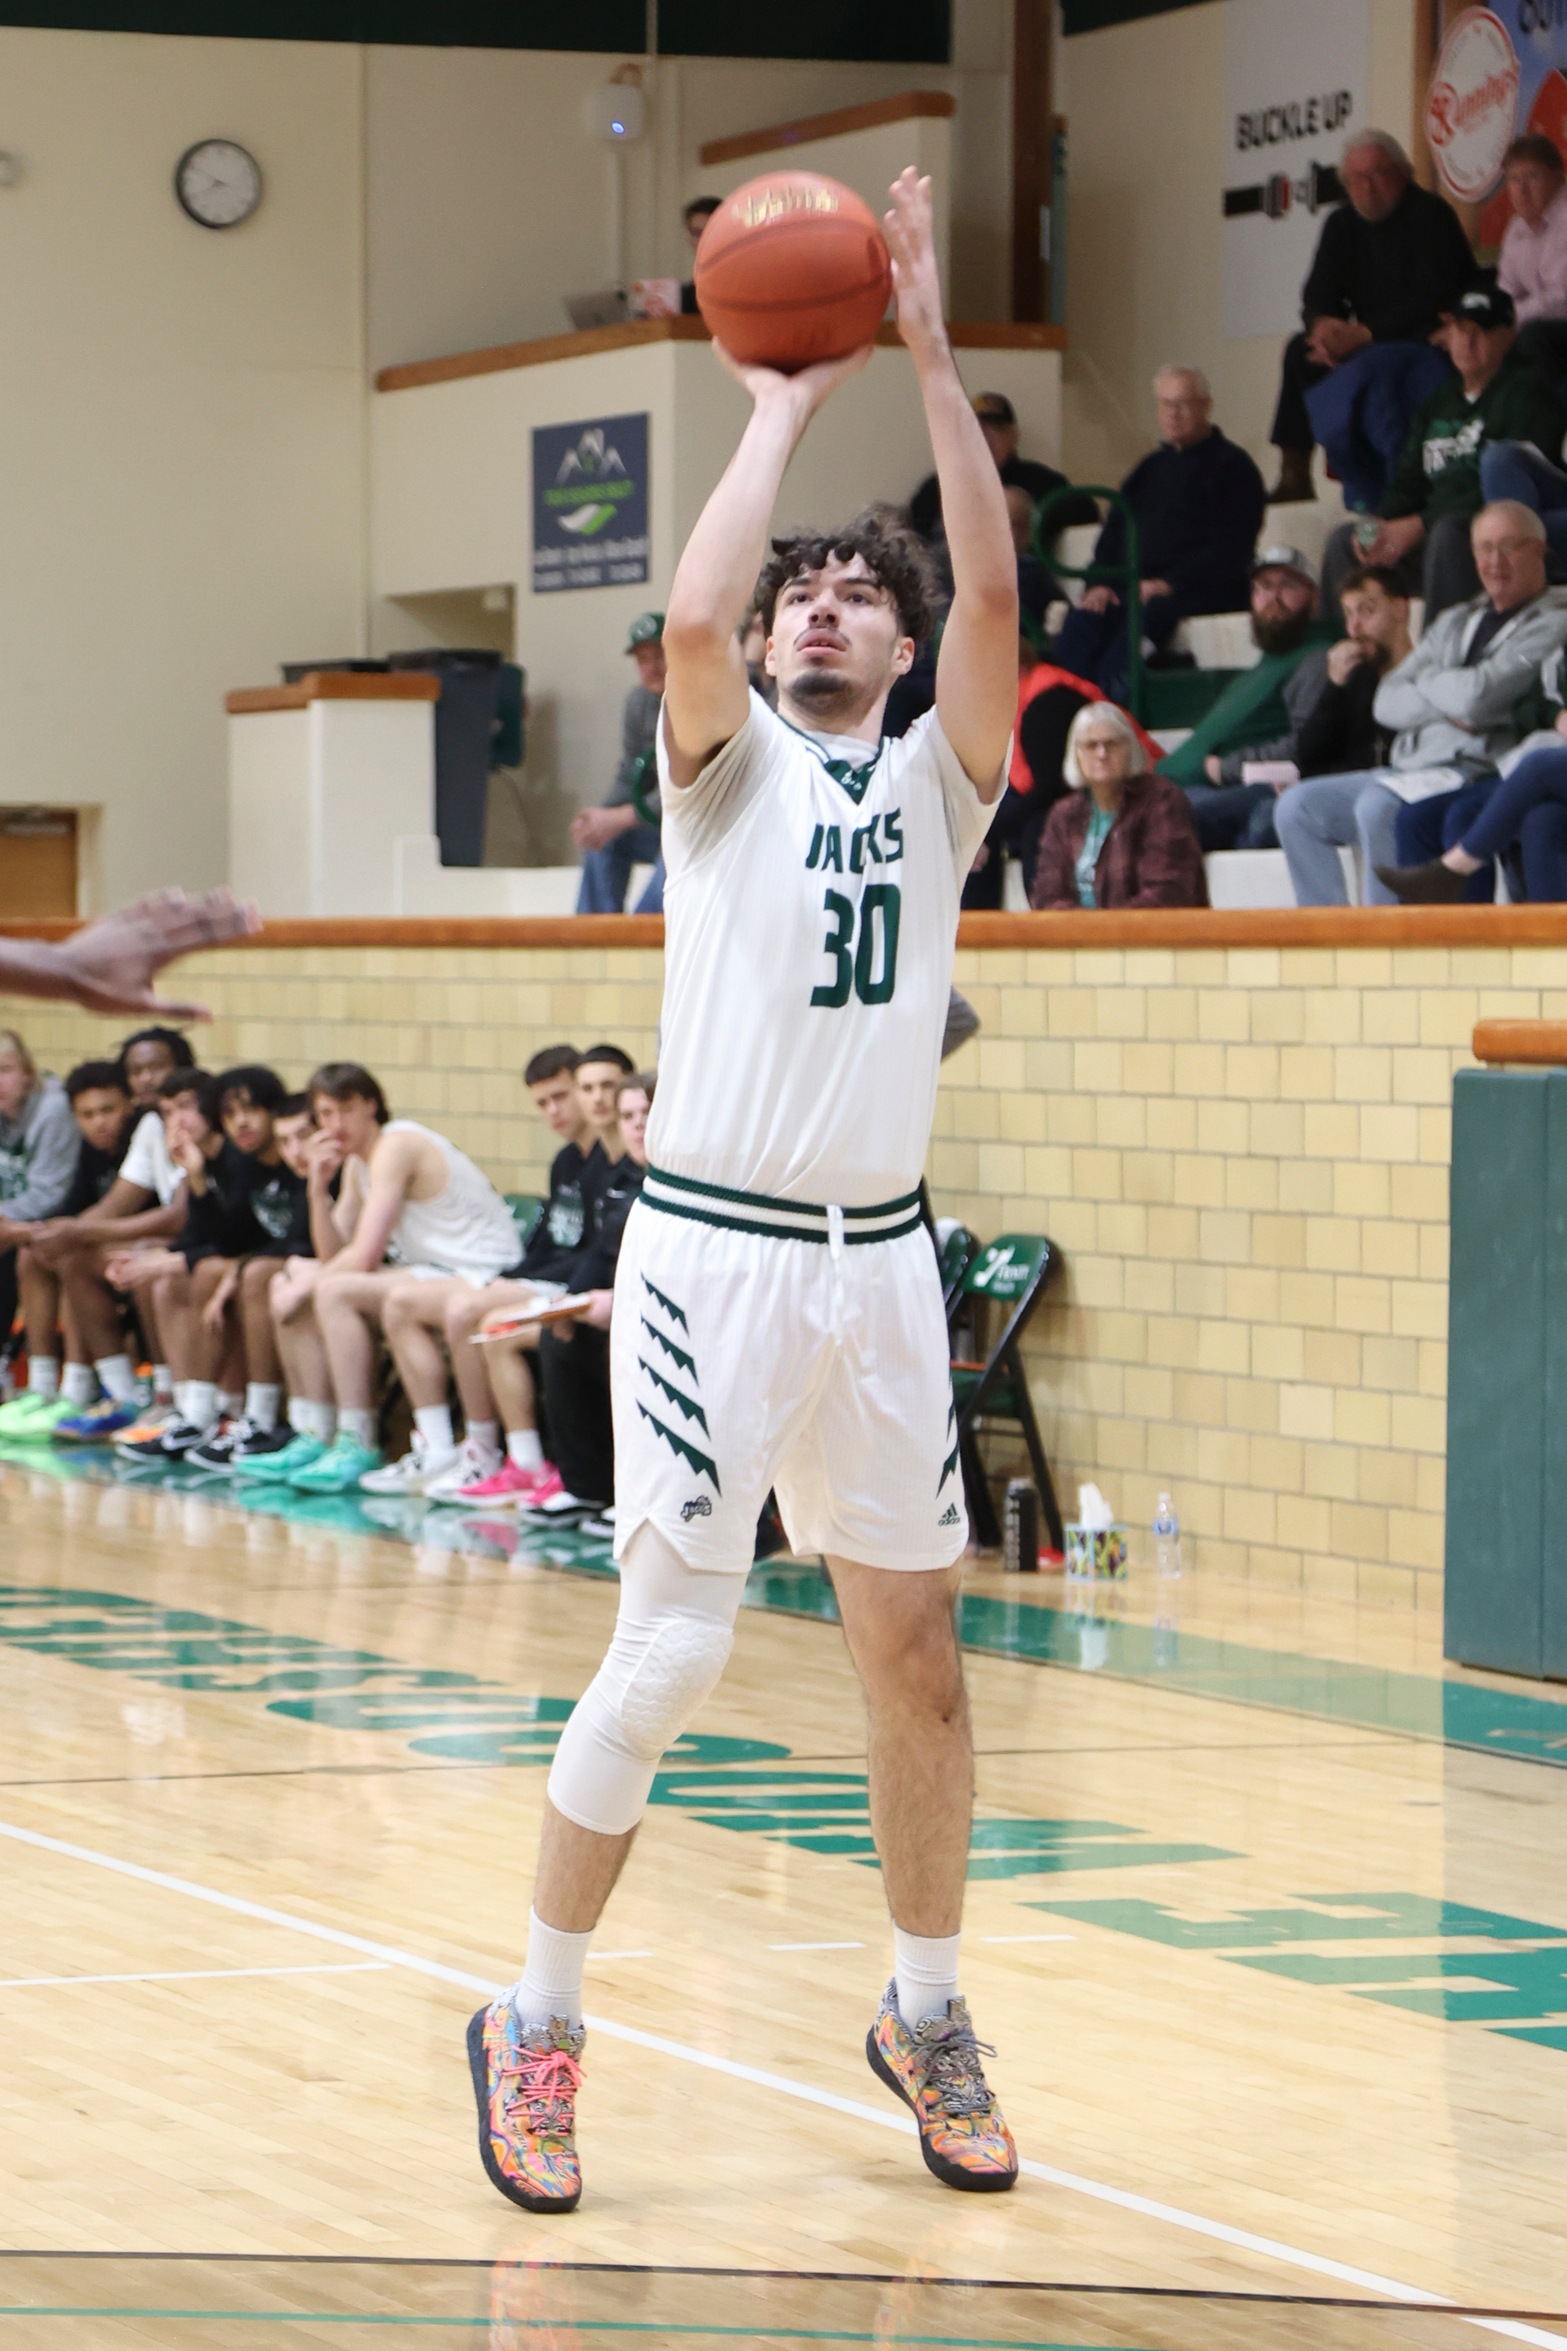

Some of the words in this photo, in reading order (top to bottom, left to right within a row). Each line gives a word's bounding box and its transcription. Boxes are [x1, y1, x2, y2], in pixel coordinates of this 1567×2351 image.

[1236, 97, 1319, 151] BUCKLE
[1322, 89, 1353, 131] UP
[805, 807, 904, 874] JACKS
[810, 883, 901, 1008] 30
[1016, 1892, 1567, 2052] HE
